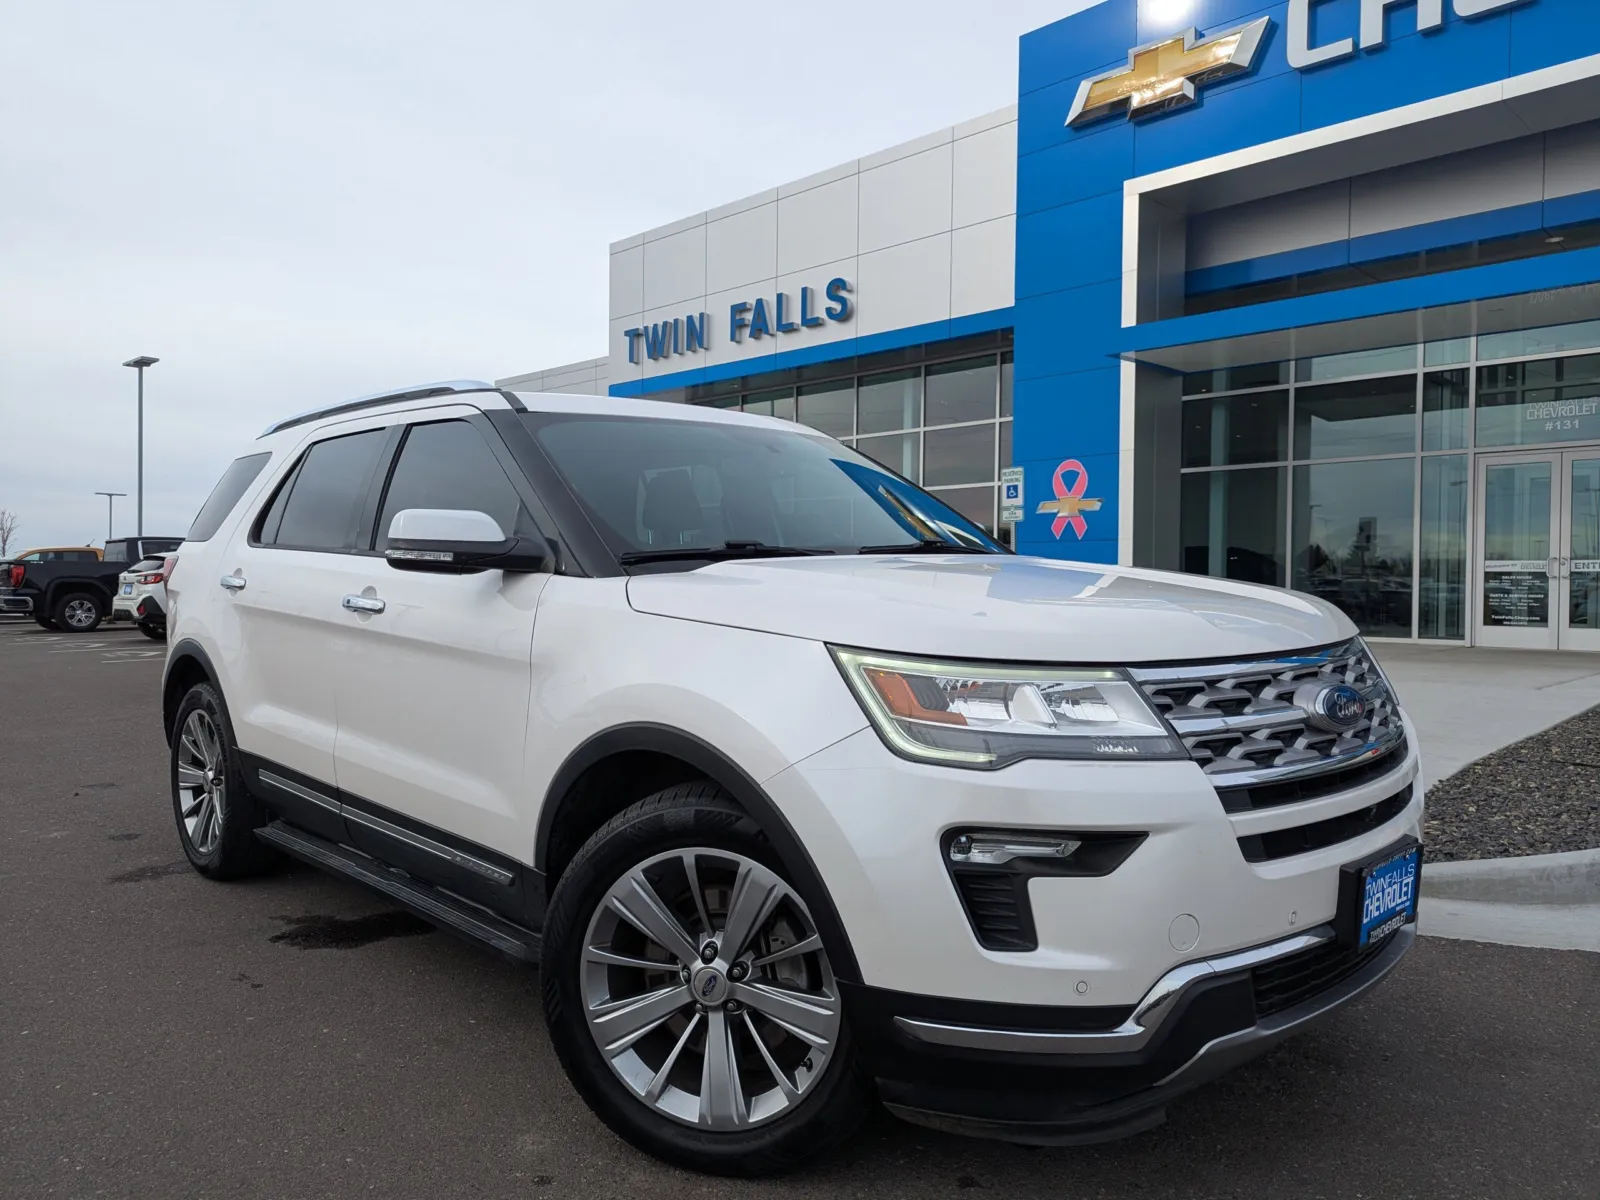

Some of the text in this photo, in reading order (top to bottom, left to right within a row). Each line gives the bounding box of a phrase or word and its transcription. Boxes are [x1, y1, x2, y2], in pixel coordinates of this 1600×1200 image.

[1287, 0, 1519, 69] CH
[624, 277, 853, 364] TWIN FALLS
[1527, 403, 1598, 420] CHEVROLET
[1545, 419, 1579, 431] #131
[1575, 562, 1600, 570] ENT
[1335, 692, 1362, 718] Ford
[1366, 863, 1415, 899] TWINFALLS
[1363, 877, 1414, 924] CHEVROLET
